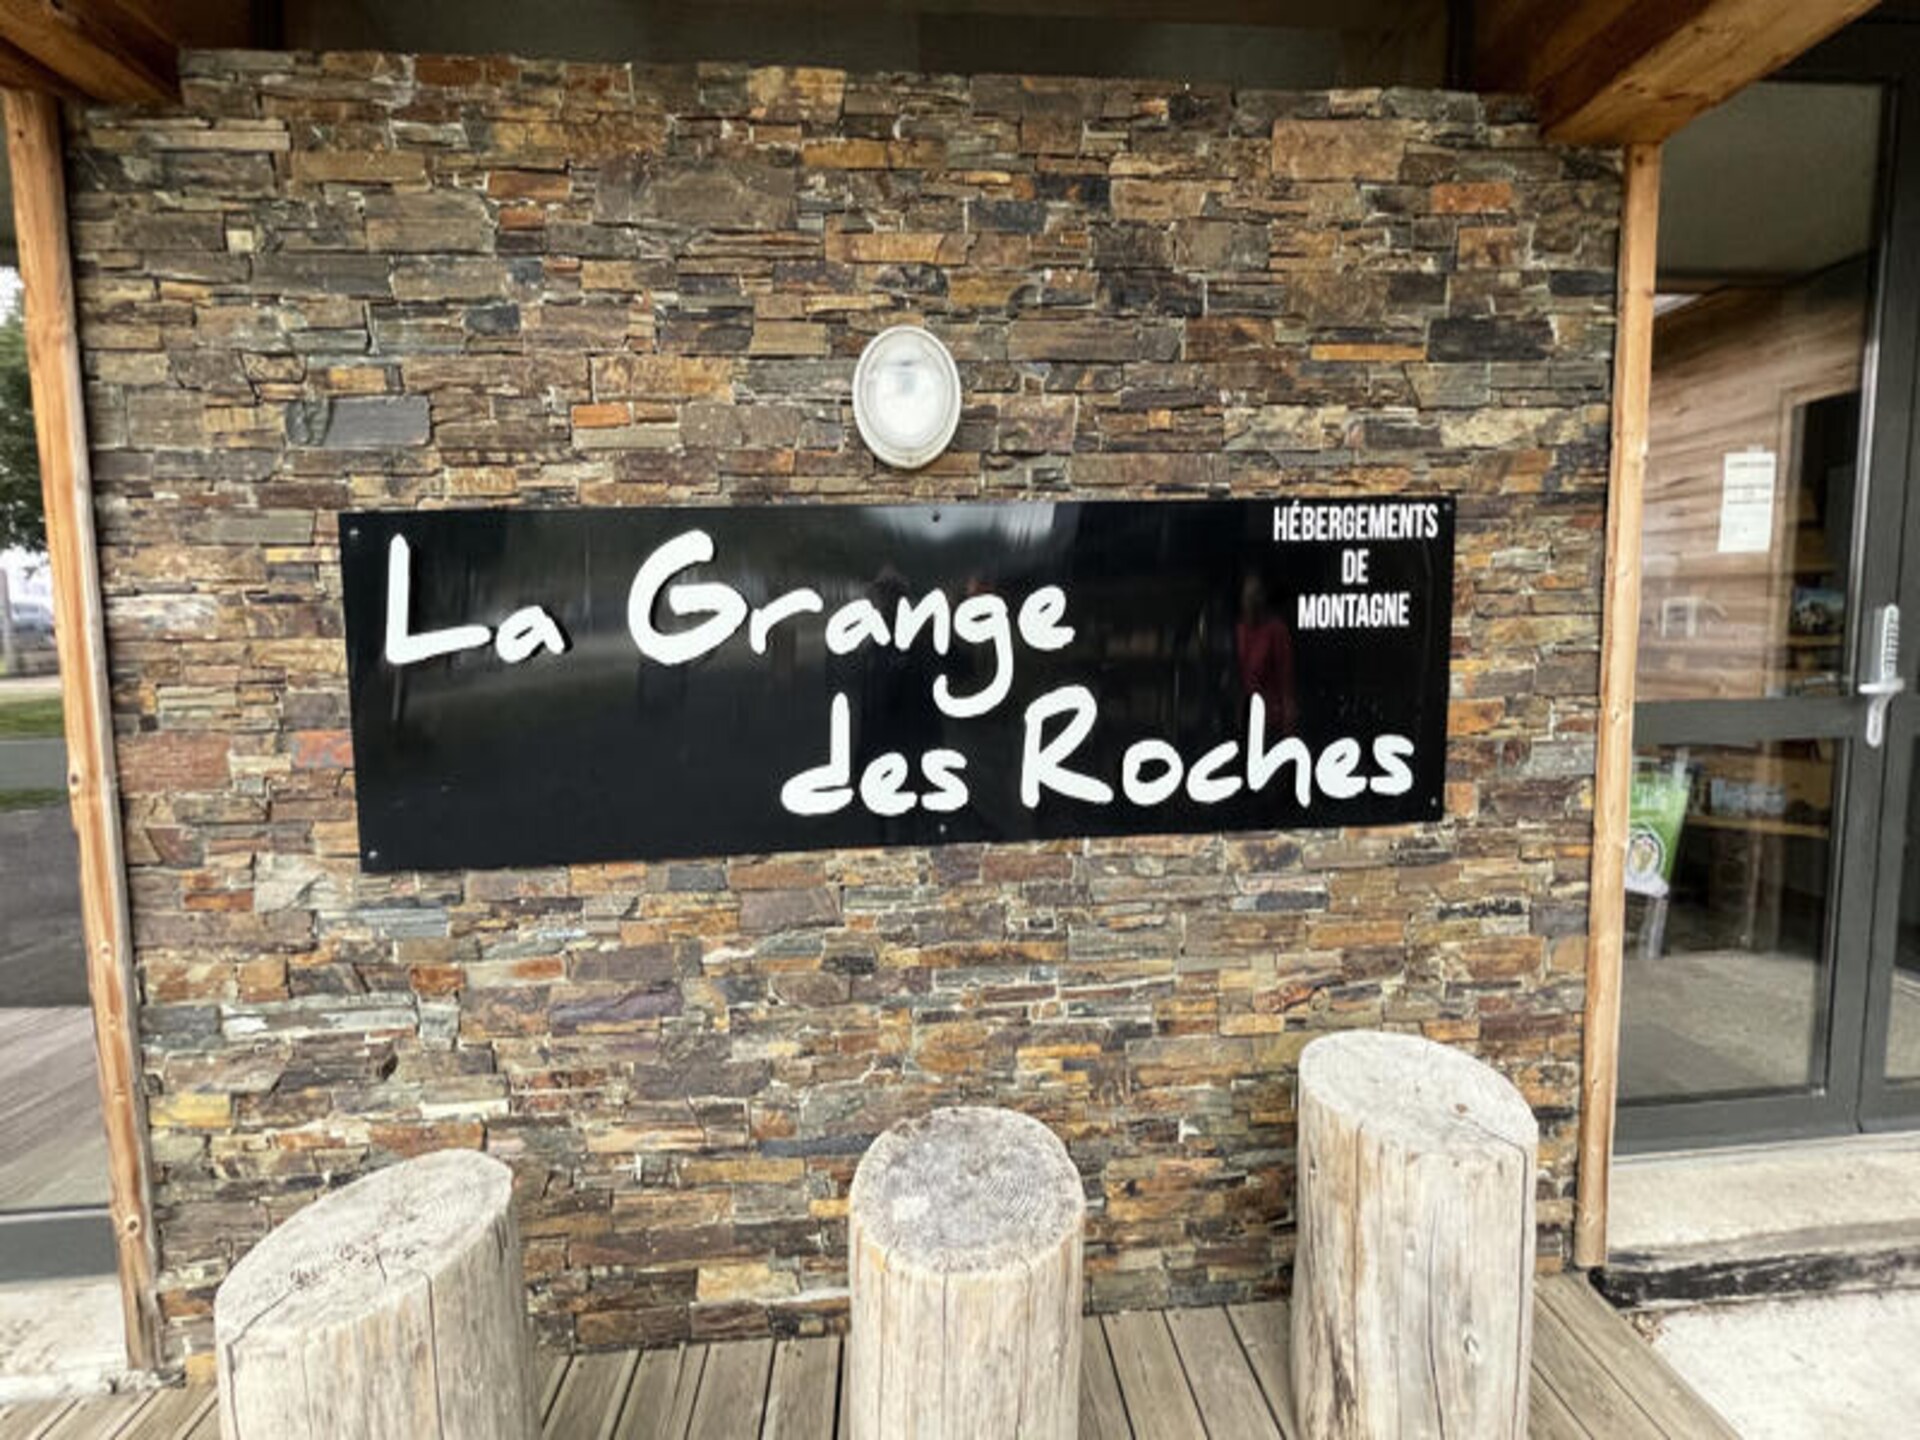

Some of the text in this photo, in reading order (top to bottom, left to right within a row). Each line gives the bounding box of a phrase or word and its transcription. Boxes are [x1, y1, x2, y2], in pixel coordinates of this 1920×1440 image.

[1273, 499, 1439, 541] HÉBERGEMENTS
[1341, 548, 1370, 585] DE
[385, 529, 1076, 718] La Grange
[1297, 592, 1411, 630] MONTAGNE
[780, 685, 1414, 816] des Roches
